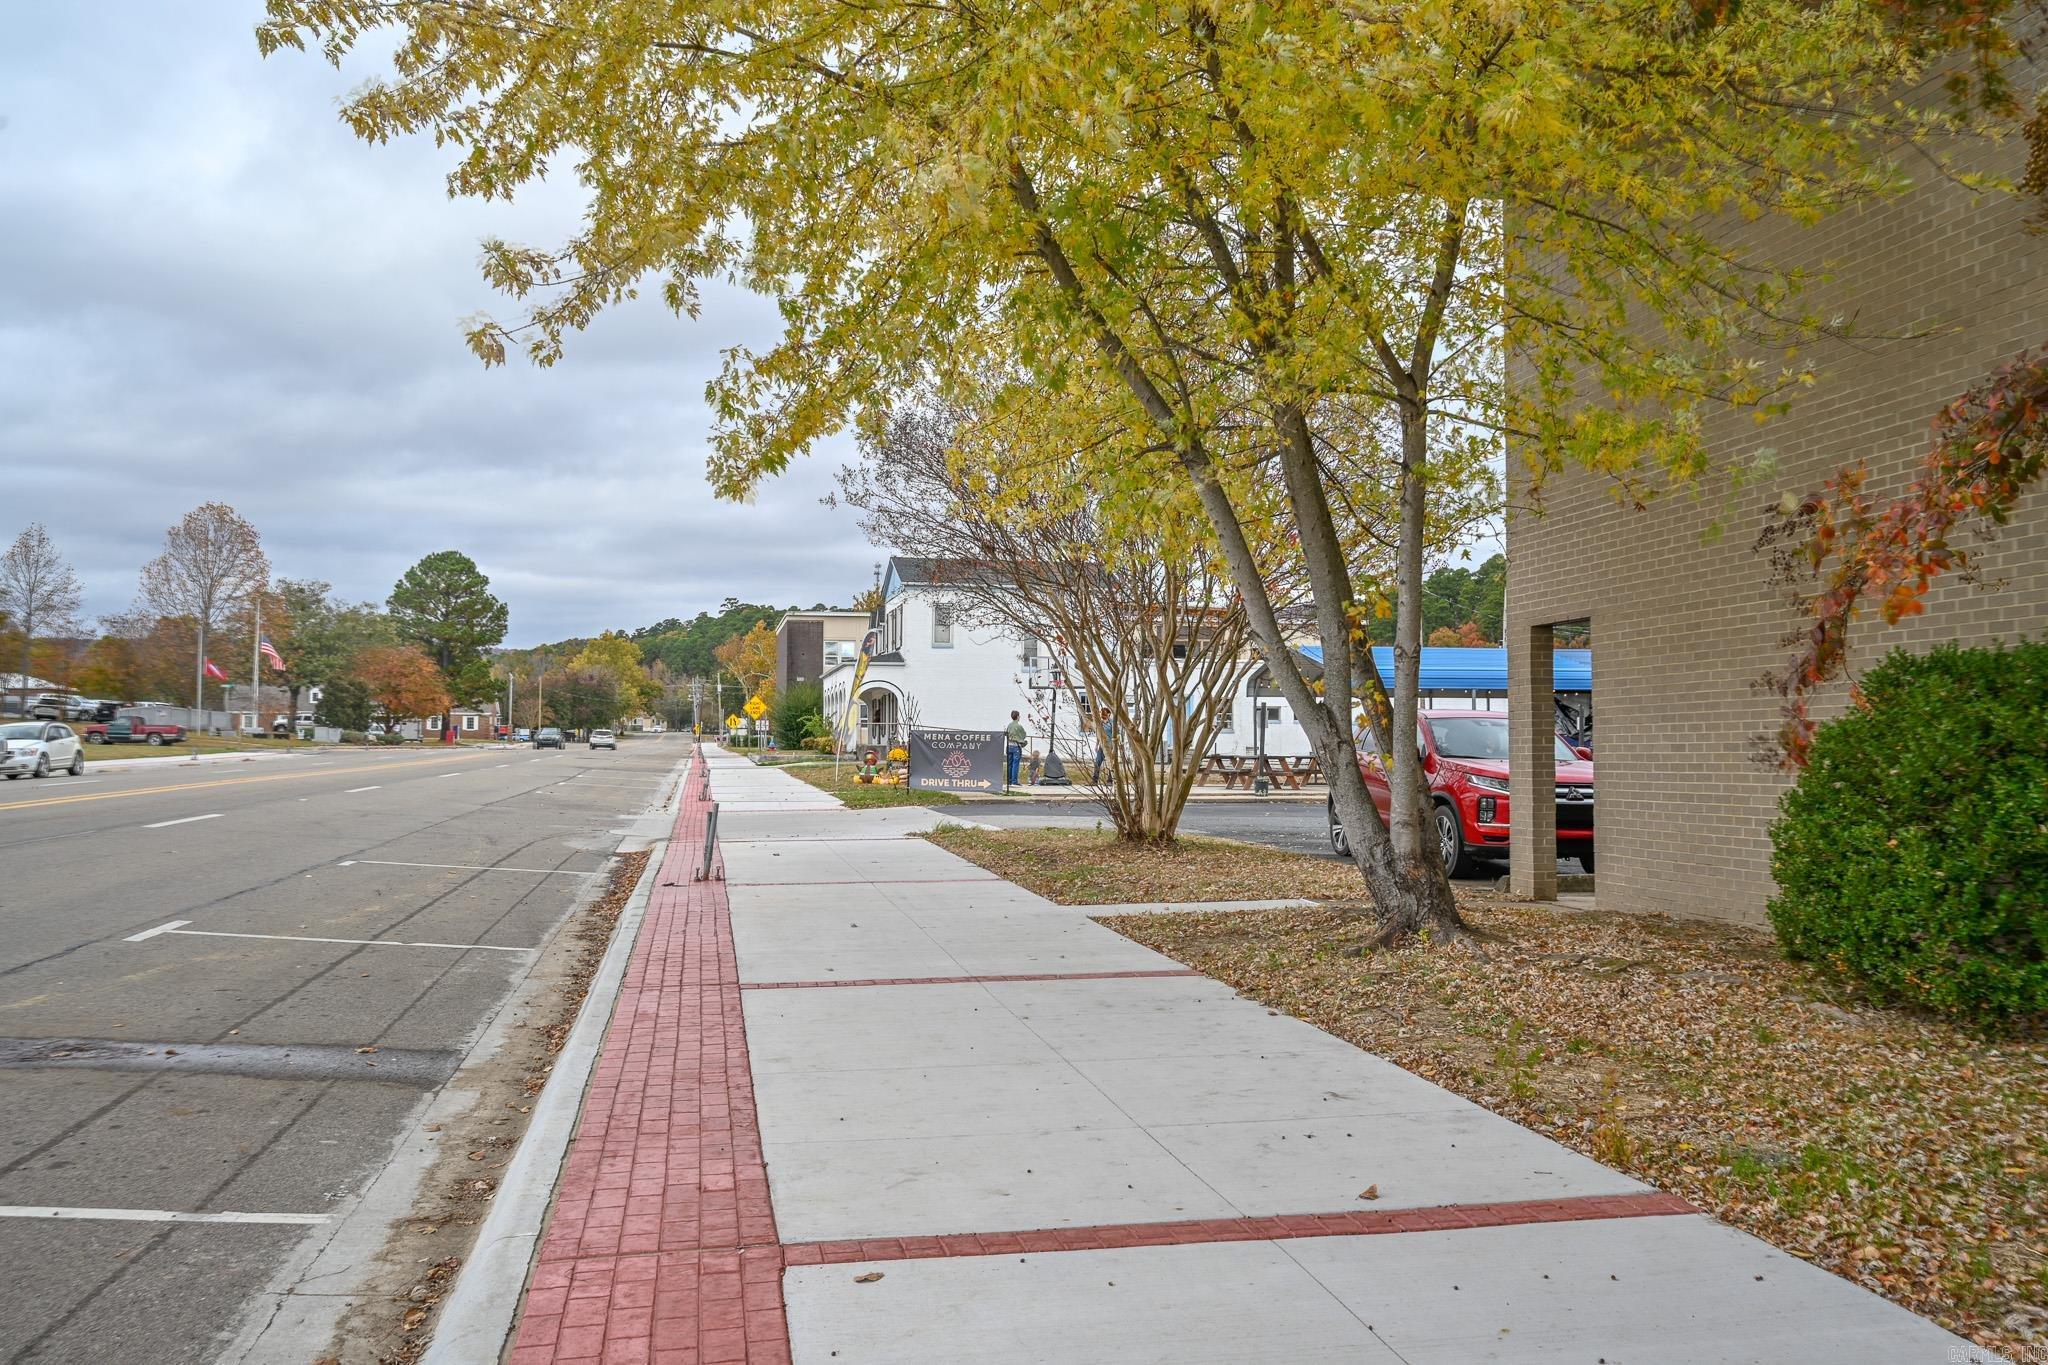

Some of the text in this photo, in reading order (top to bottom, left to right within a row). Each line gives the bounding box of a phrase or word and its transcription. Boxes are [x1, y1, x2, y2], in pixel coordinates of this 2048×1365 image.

[924, 733, 951, 741] MENA
[931, 741, 982, 750] COMPANY
[921, 778, 977, 788] DRIVE THRU
